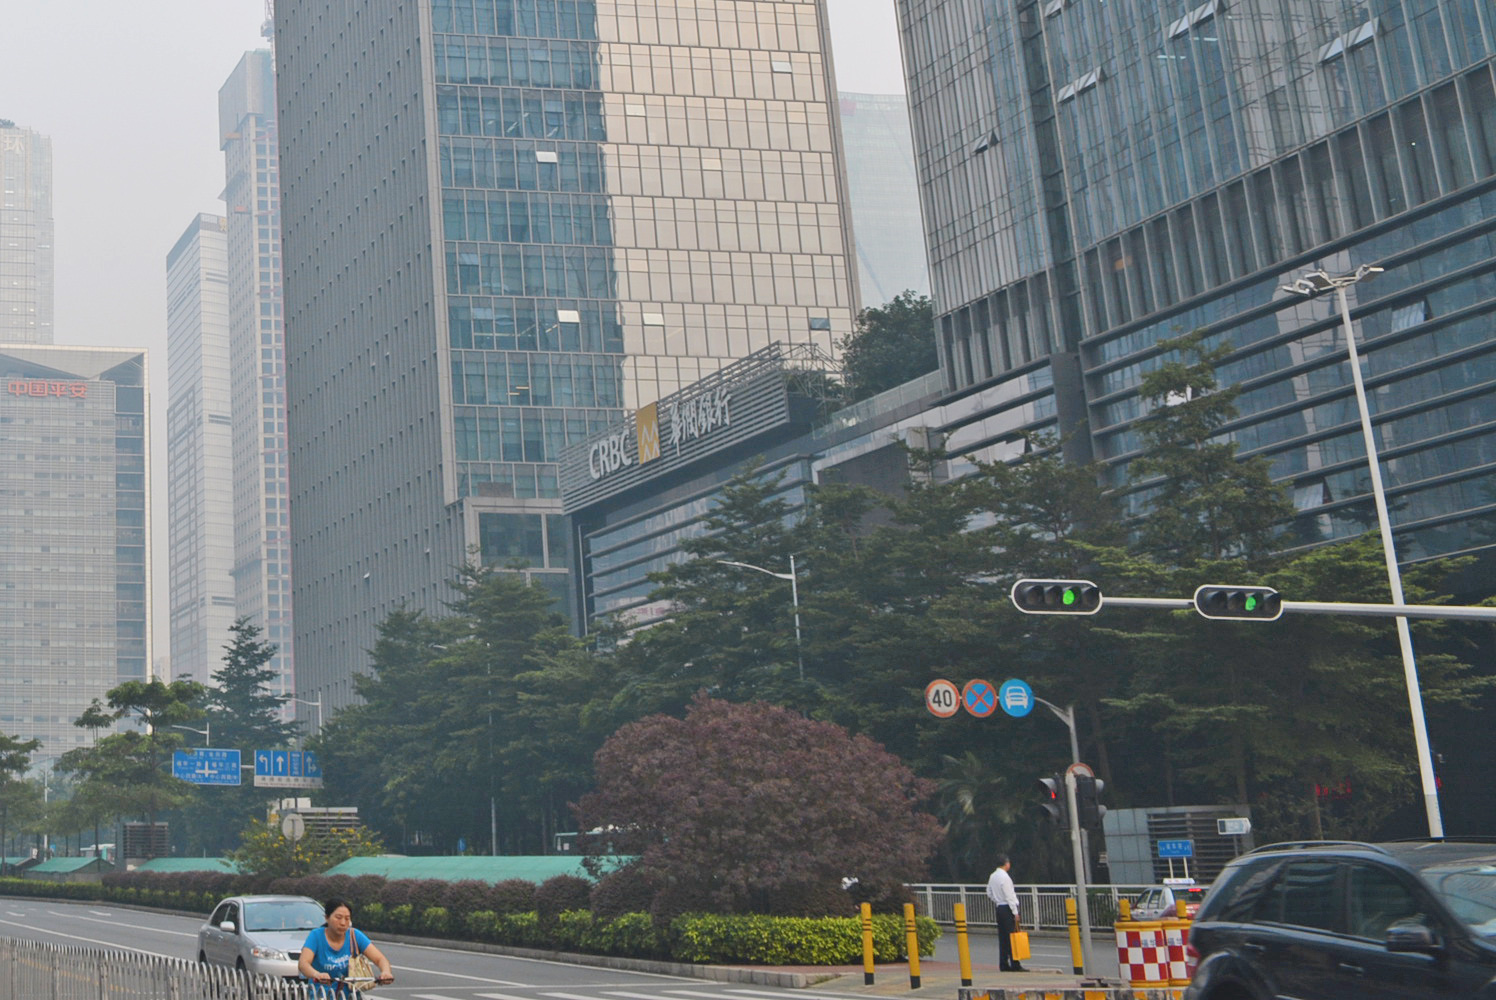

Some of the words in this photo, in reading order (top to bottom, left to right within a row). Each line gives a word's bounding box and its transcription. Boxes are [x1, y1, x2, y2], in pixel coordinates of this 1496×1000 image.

[7, 380, 88, 399] 中国平安
[589, 428, 632, 480] CRBC
[932, 689, 953, 708] 40
